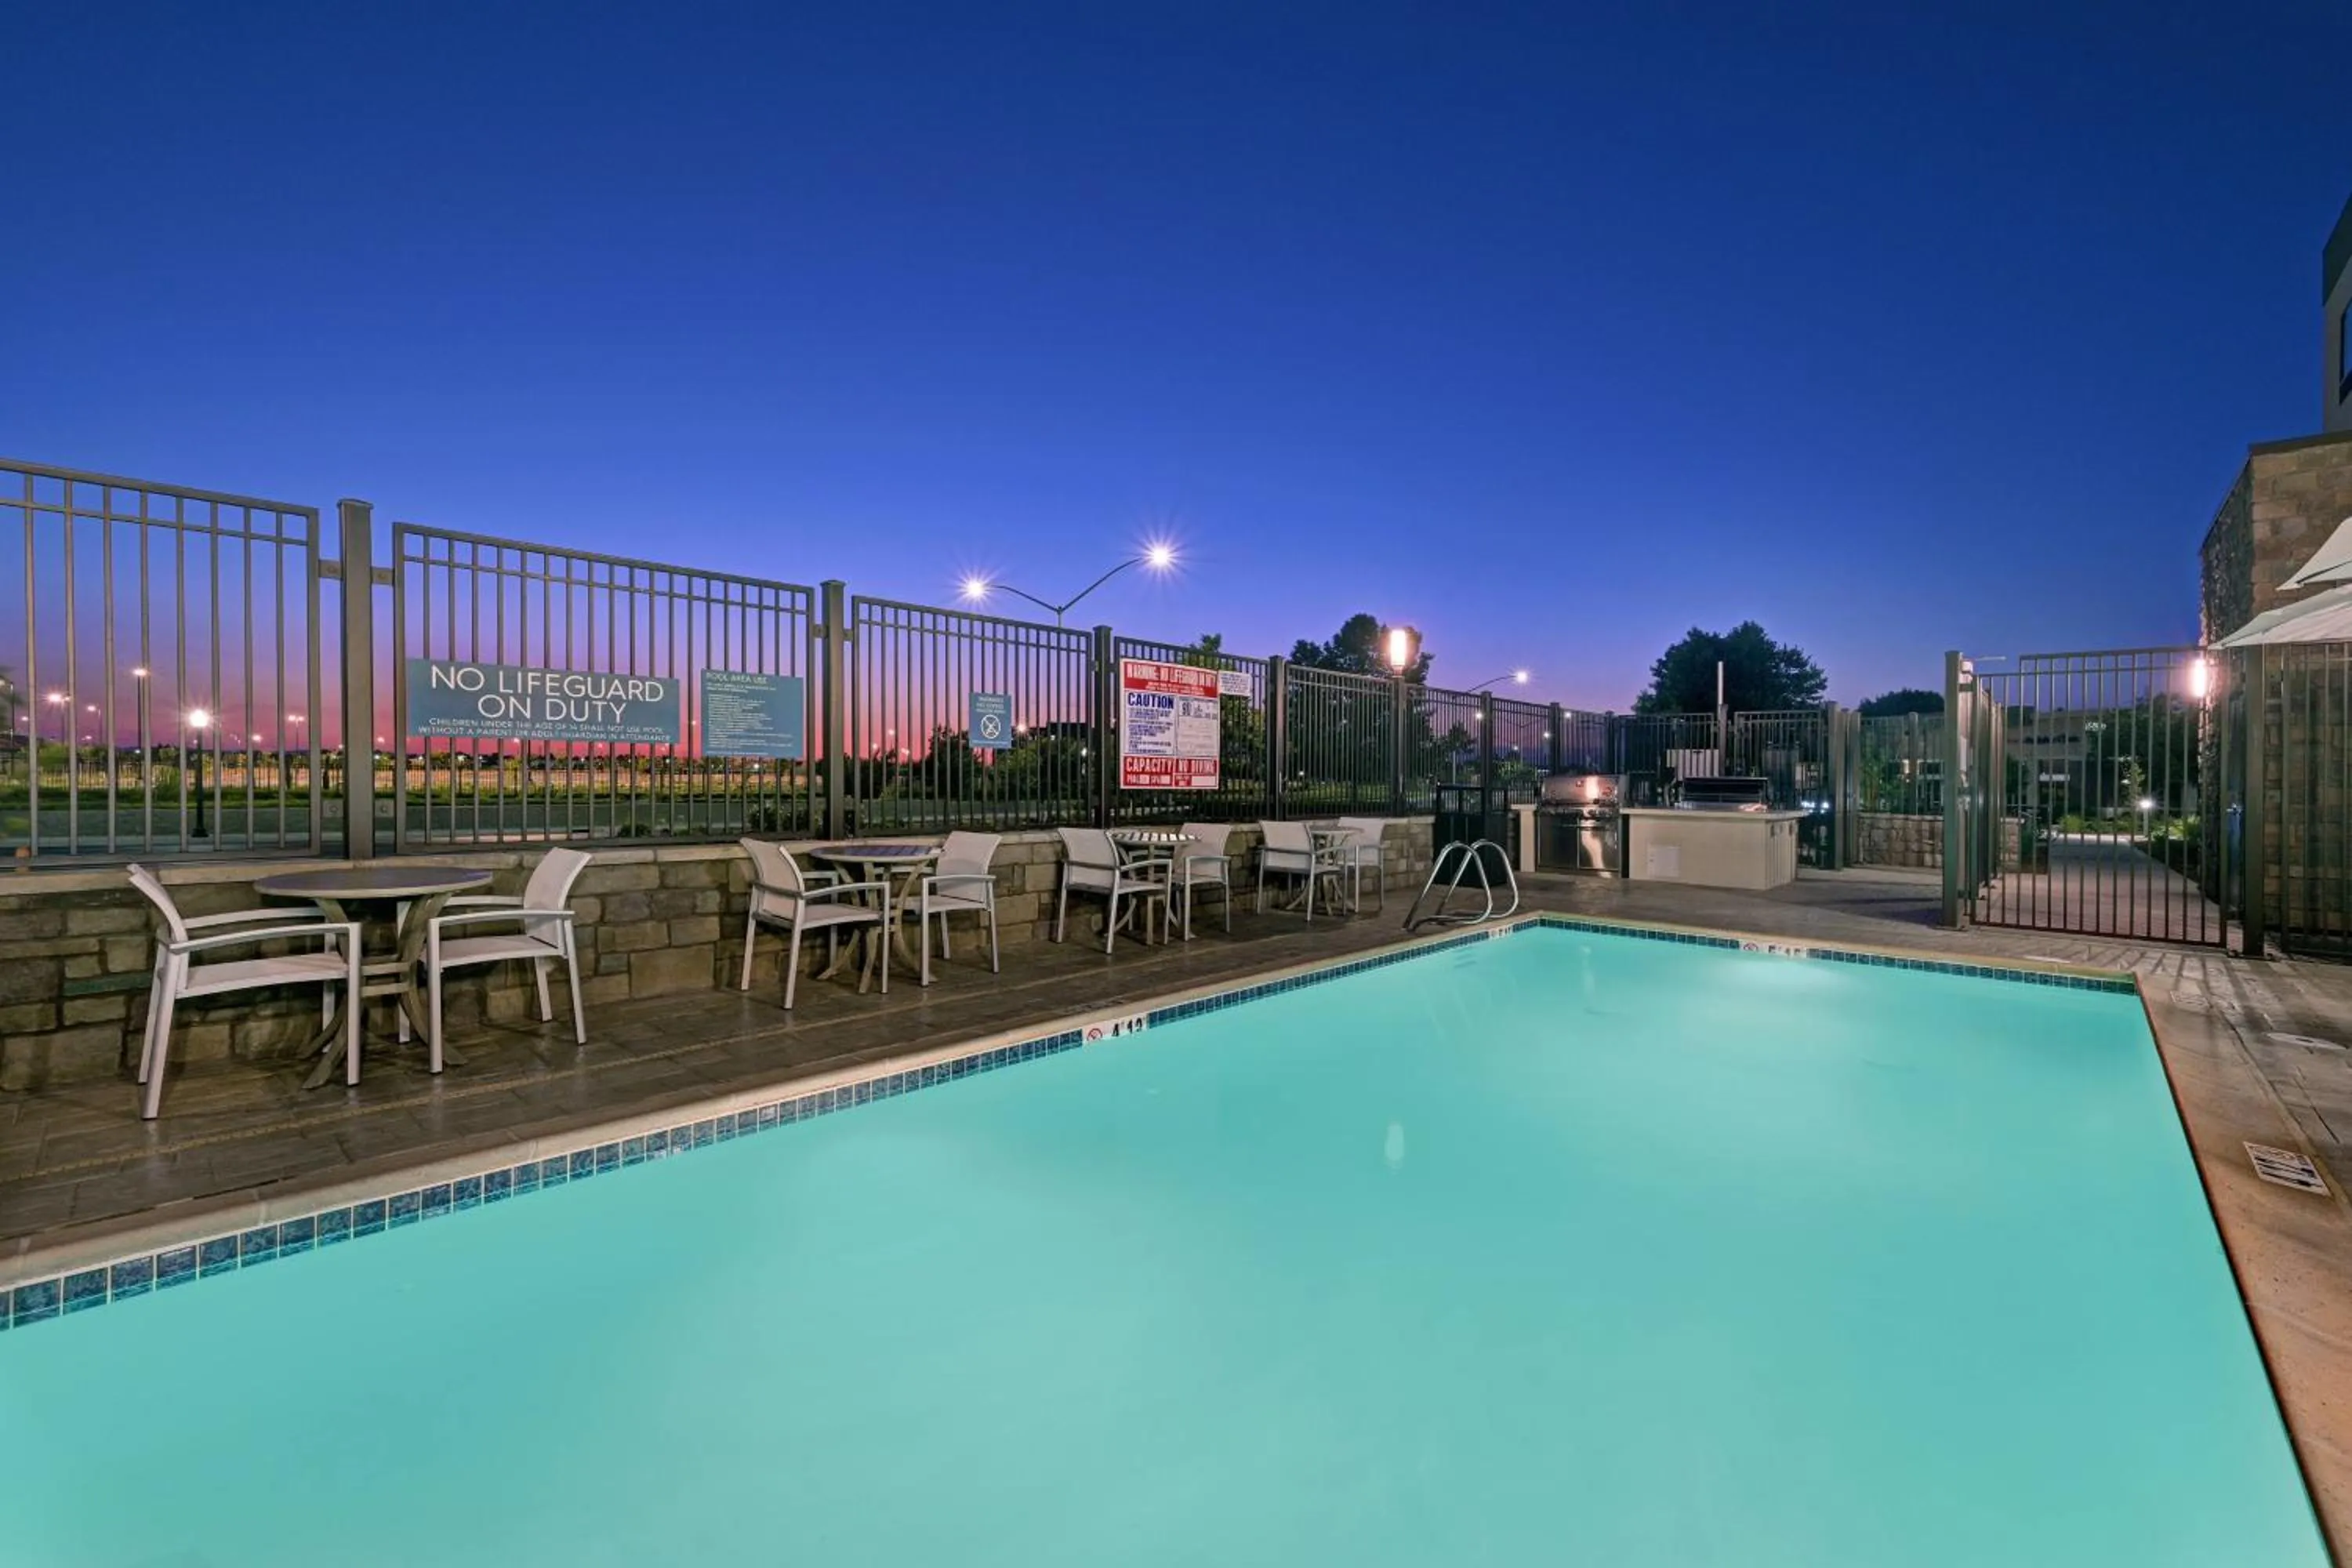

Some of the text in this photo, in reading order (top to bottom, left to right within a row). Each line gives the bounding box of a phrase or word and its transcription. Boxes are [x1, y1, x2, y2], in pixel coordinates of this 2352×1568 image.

[431, 664, 664, 702] NO LIFEGUARD
[477, 694, 626, 723] ON DUTY
[1128, 692, 1174, 709] CAUTION
[419, 726, 464, 735] WITHOUT
[429, 717, 478, 727] CHILDREN
[481, 720, 512, 728] UNDER
[534, 721, 554, 730] AGE
[608, 724, 625, 733] NOT
[1126, 757, 1172, 773] CAPACITY
